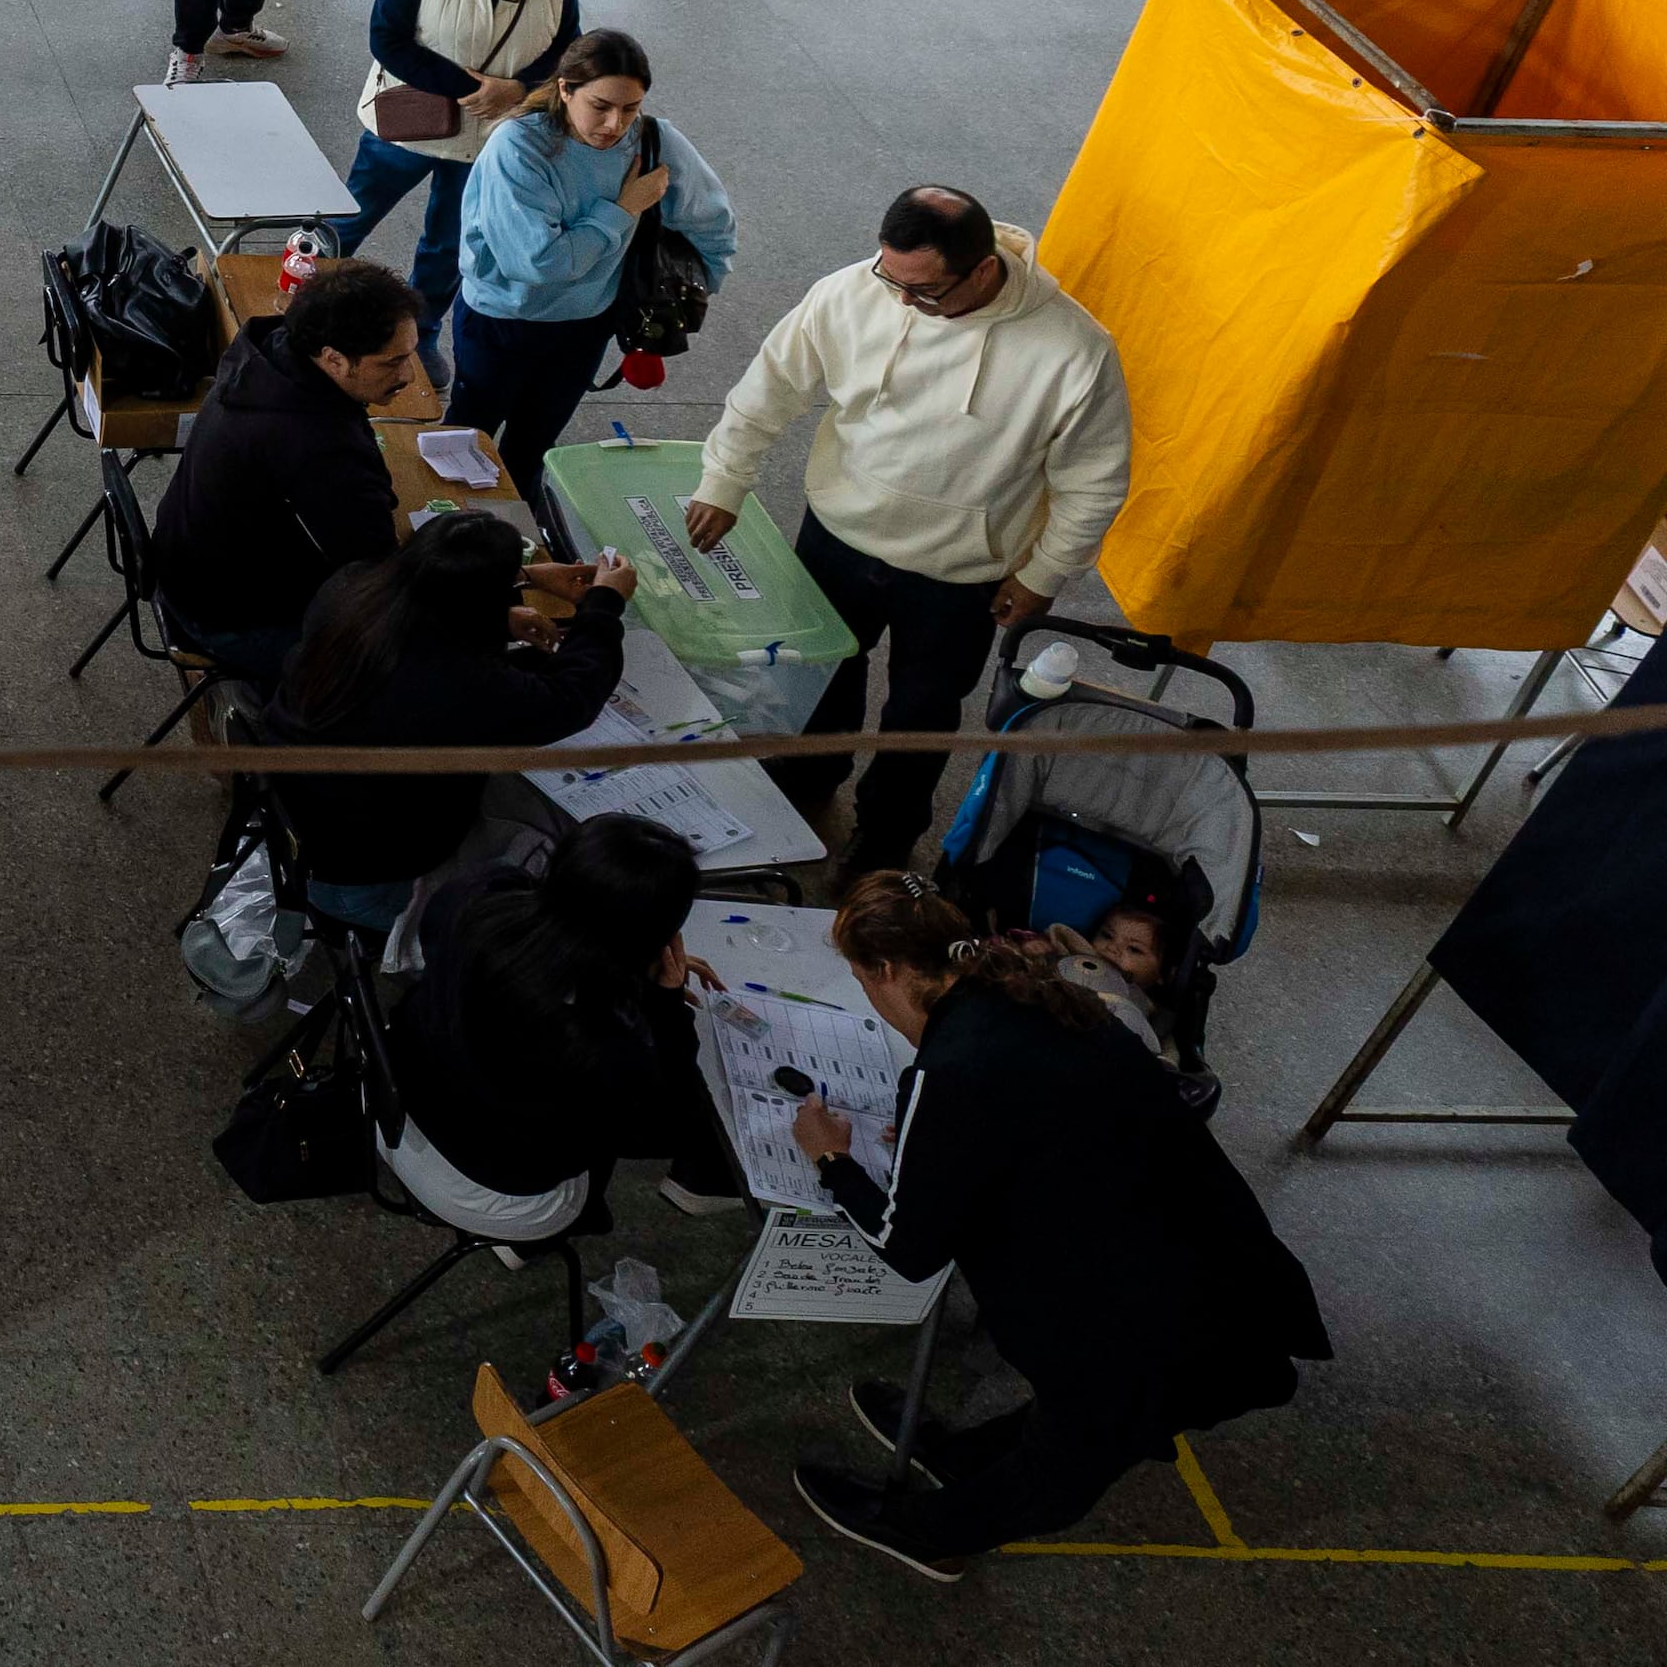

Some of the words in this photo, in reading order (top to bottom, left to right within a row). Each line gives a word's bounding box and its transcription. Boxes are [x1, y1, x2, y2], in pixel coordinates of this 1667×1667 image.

[757, 1270, 767, 1279] 2
[753, 1281, 761, 1289] 3
[749, 1290, 757, 1299] 4
[746, 1303, 753, 1311] 5
